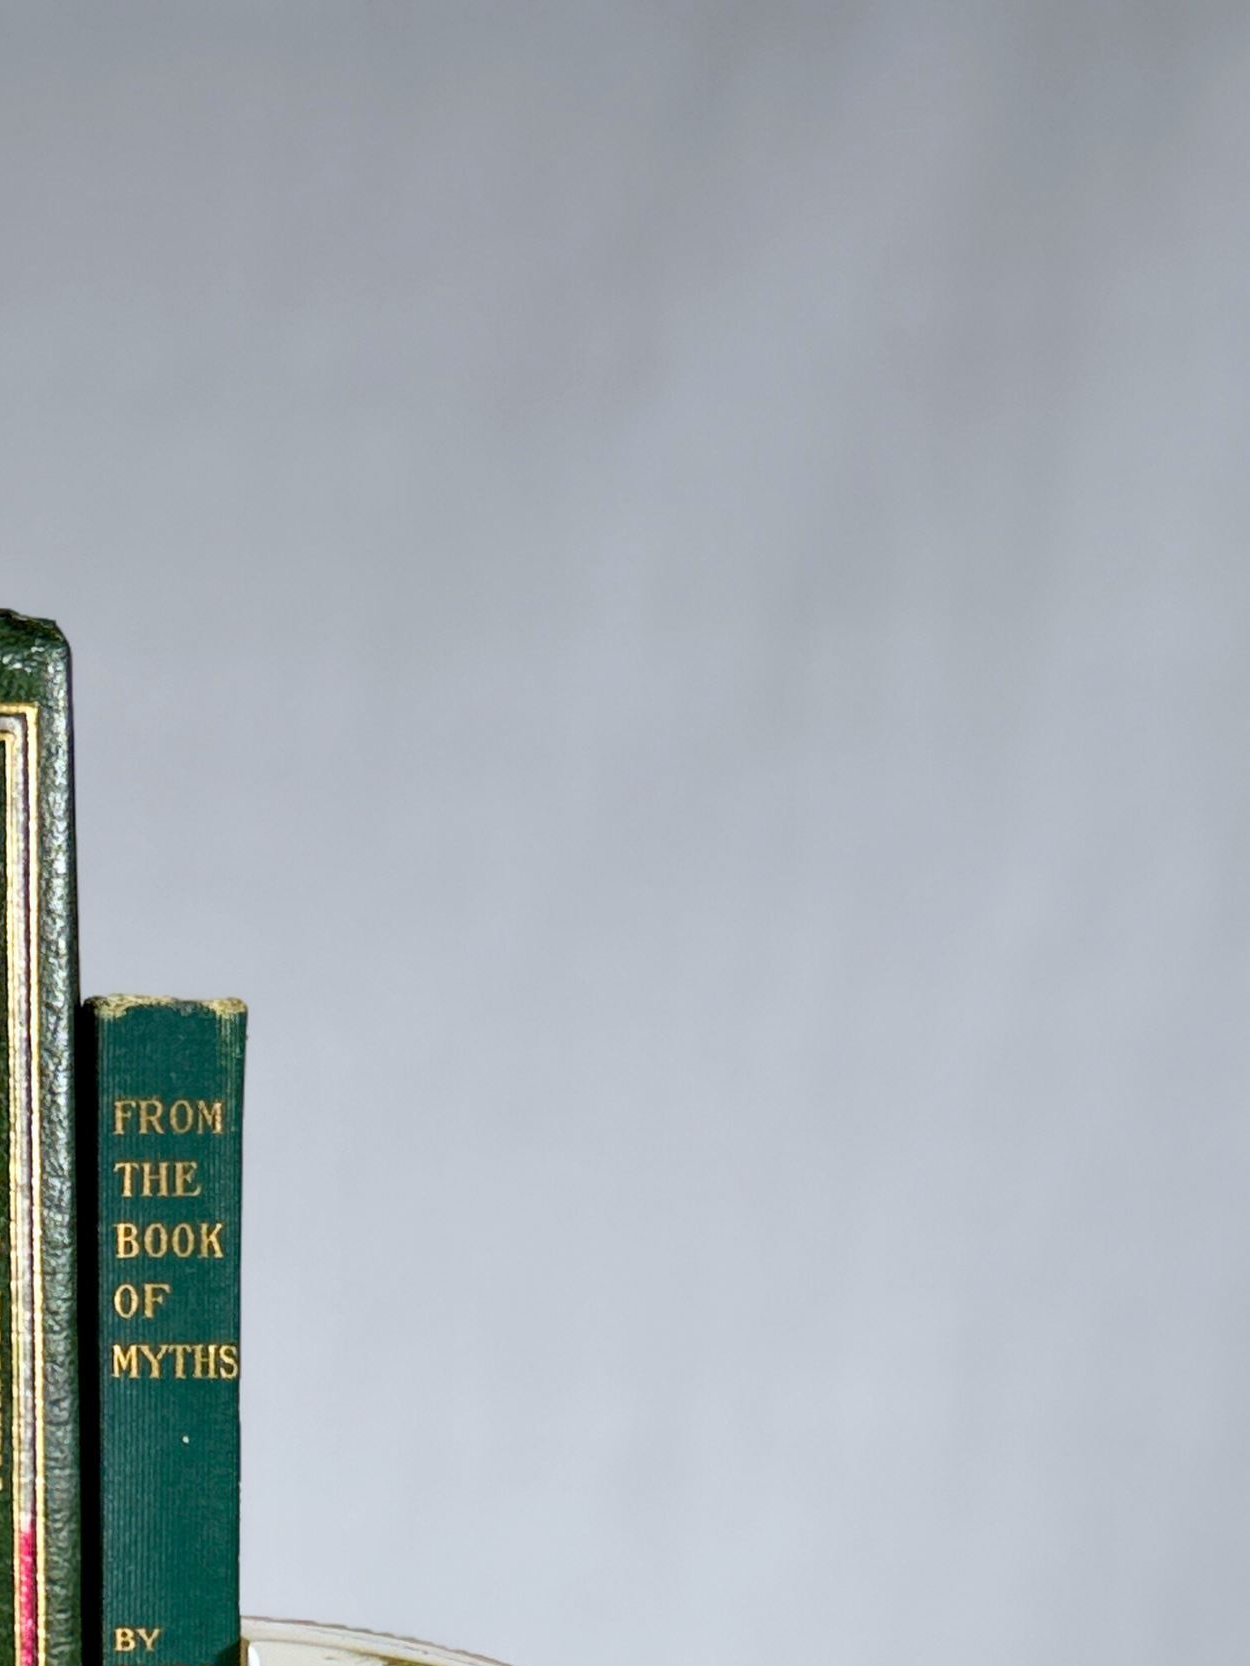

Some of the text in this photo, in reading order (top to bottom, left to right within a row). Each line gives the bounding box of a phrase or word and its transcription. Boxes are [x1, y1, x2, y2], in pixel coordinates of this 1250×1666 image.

[112, 1099, 225, 1135] FROM
[113, 1161, 202, 1197] THE
[113, 1222, 225, 1259] BOOK
[113, 1283, 171, 1319] OF
[111, 1343, 239, 1380] MYTHS
[113, 1626, 162, 1652] BY
